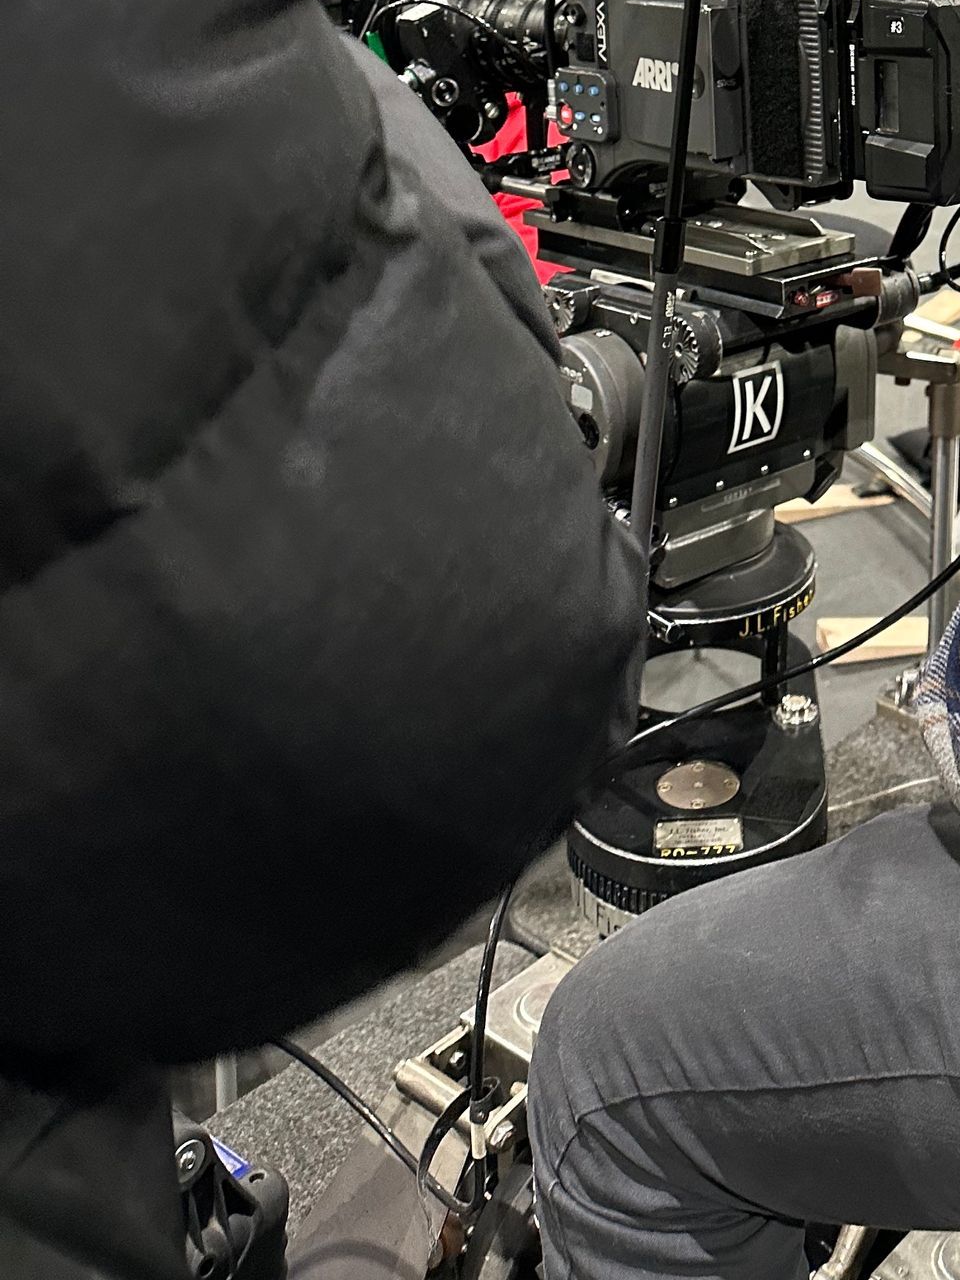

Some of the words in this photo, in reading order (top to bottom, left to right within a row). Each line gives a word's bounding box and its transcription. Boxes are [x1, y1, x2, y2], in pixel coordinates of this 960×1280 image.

[595, 0, 608, 62] ALEXA
[890, 21, 903, 34] #3
[631, 56, 673, 93] ARRI
[741, 375, 773, 441] K
